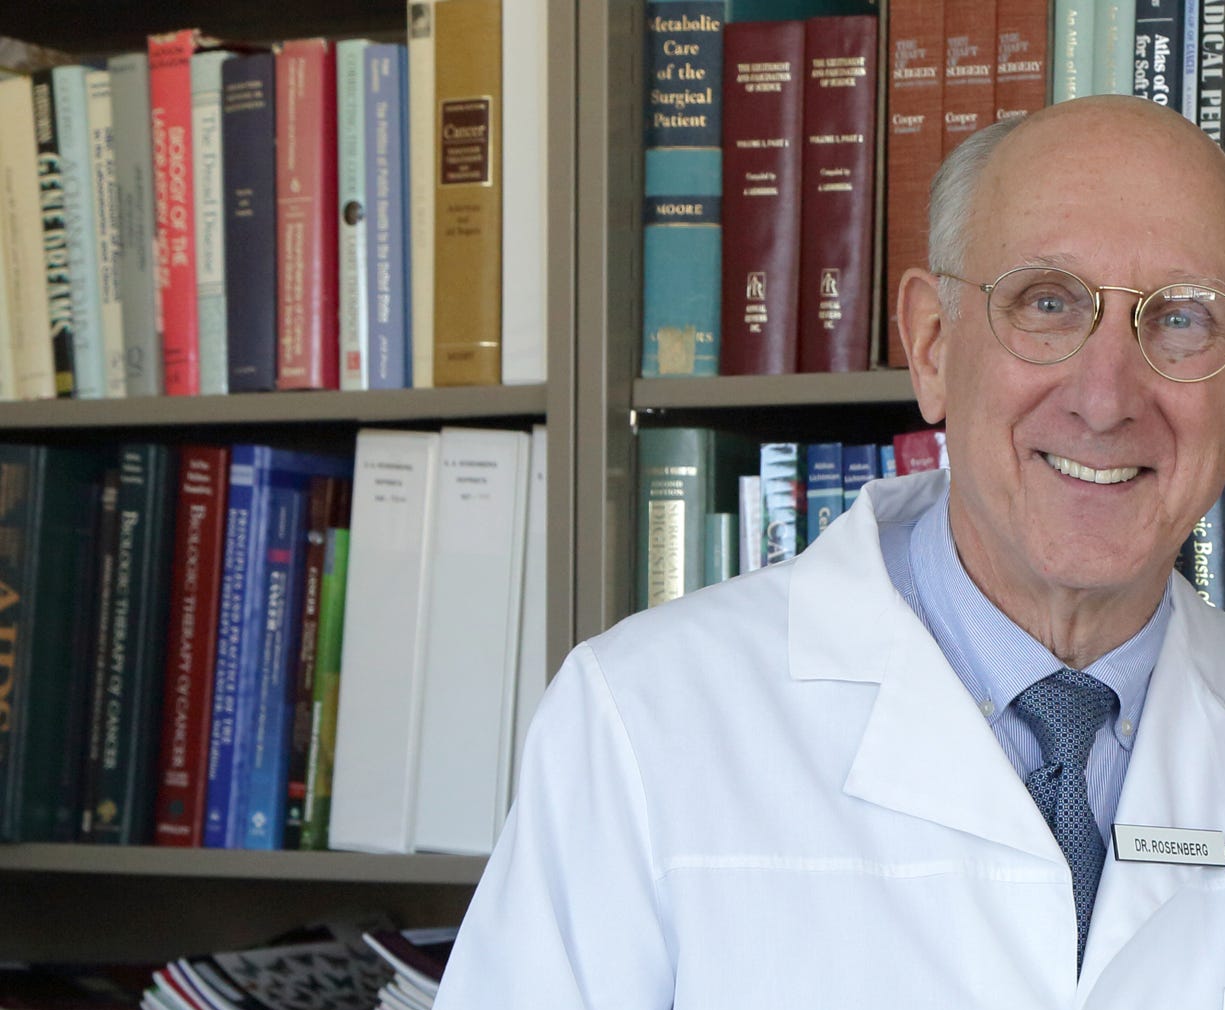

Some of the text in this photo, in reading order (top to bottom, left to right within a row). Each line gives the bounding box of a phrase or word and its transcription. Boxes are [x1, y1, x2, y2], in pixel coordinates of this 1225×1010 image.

[649, 14, 720, 32] Metabolic
[663, 40, 700, 56] Care
[1134, 34, 1151, 90] for Soft
[1153, 33, 1170, 90] Atlas of
[657, 63, 706, 79] of the
[650, 87, 713, 107] Surgical
[653, 112, 707, 127] Patient
[443, 124, 488, 141] Cancer
[168, 126, 187, 202] BIOLOGY
[656, 203, 704, 215] MOORE
[170, 205, 187, 232] OF
[1194, 541, 1214, 587] Basis
[1134, 838, 1209, 856] DR. ROSENBERG
